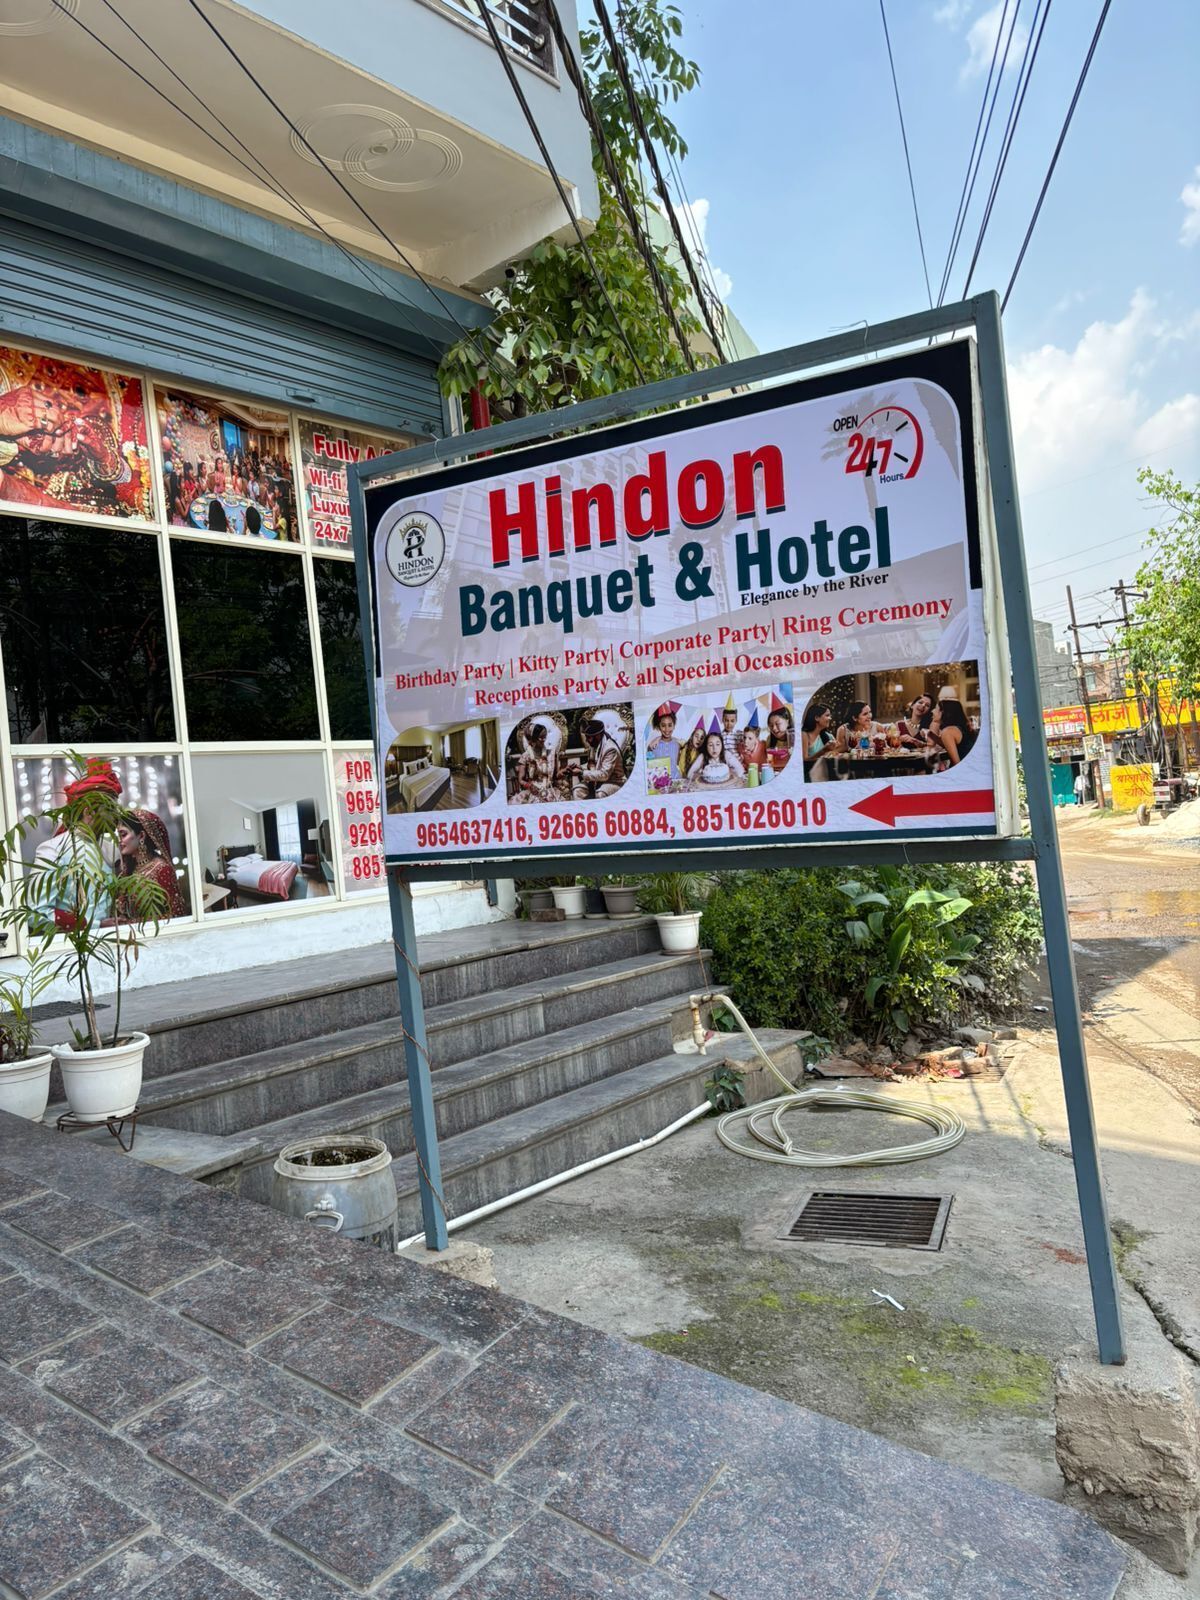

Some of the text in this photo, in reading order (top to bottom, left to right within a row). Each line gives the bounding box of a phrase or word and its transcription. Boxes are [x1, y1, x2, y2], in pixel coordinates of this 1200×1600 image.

[833, 414, 859, 432] OPEN
[314, 434, 360, 463] Fully
[309, 468, 342, 490] Wi-fi
[880, 473, 904, 484] Hours
[489, 444, 786, 568] Hindon
[315, 521, 348, 541] 24x7
[398, 556, 434, 571] HINDON
[459, 506, 891, 636] Banquet & Hotel
[740, 573, 889, 606] Elegance by the River
[395, 667, 459, 690] Birthday
[464, 661, 505, 681] Party
[518, 653, 559, 674] Kitty
[620, 632, 712, 660] Corporate
[782, 615, 832, 637] Ring
[838, 598, 953, 627] Ceremony
[475, 646, 835, 706] Receptions Party & all Special Occasions
[346, 761, 373, 783] FOR
[417, 797, 827, 847] 9654637416, 92666 60884, 8851626010
[352, 855, 386, 880] 885
